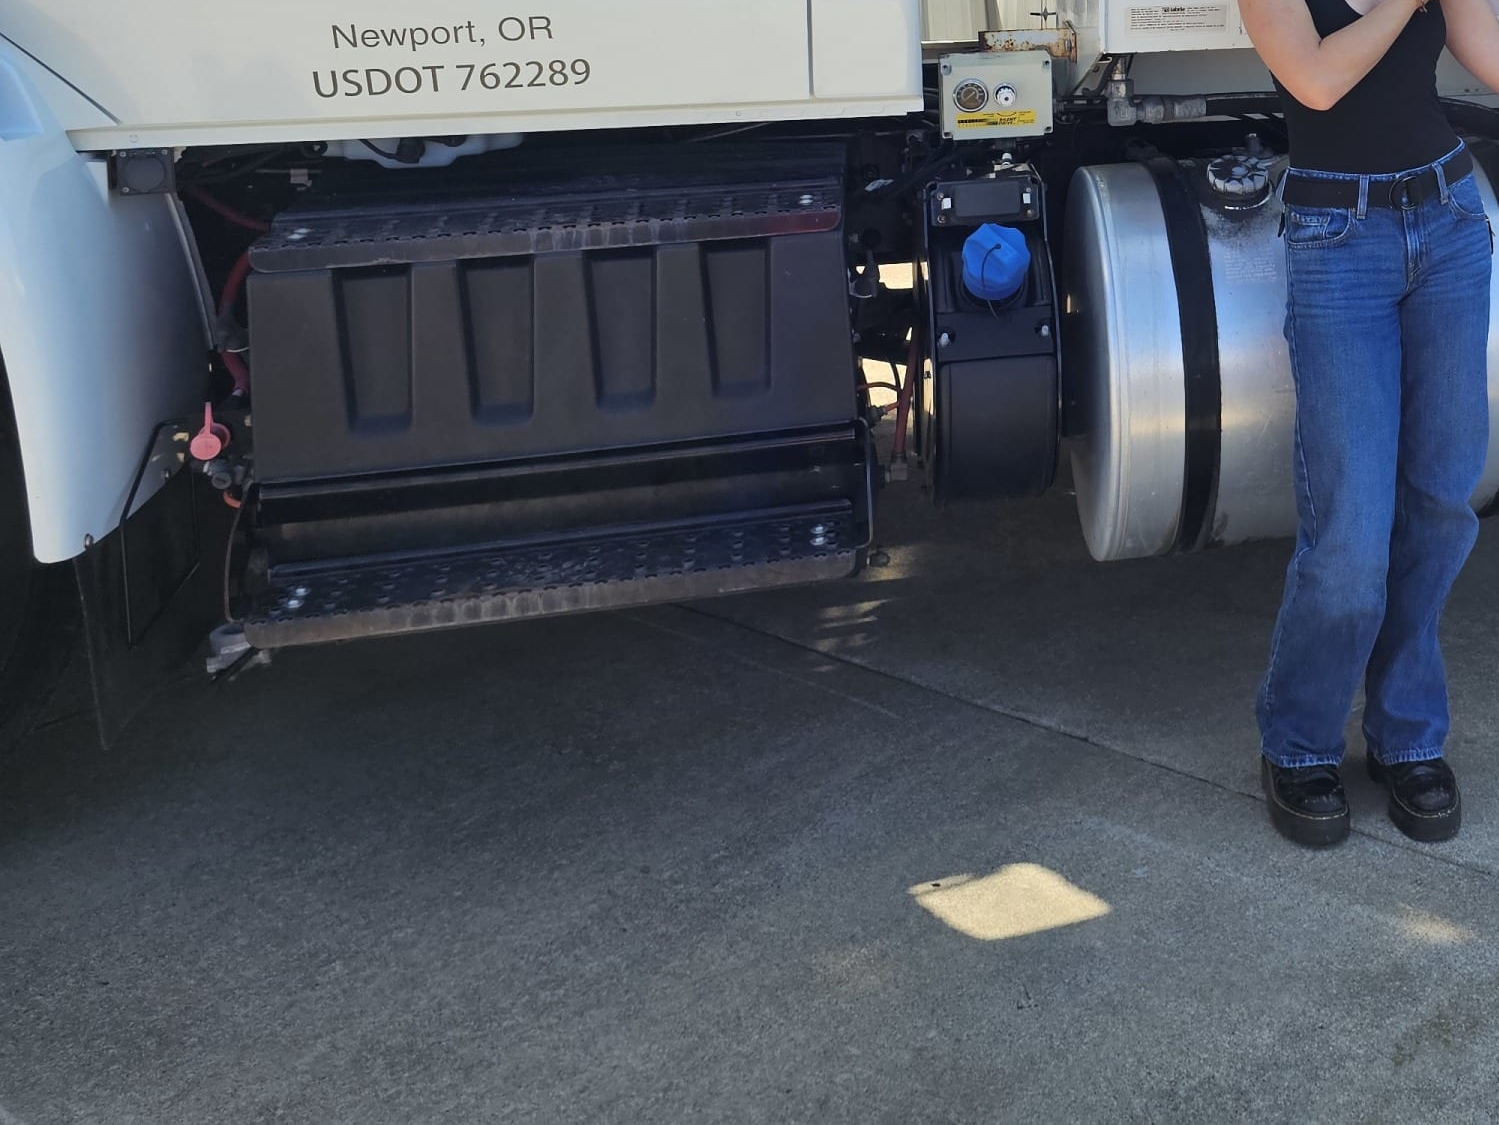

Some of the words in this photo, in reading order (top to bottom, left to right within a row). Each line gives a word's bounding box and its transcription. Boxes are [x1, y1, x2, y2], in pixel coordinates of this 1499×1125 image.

[331, 20, 486, 52] Newport,
[498, 15, 554, 42] OR
[312, 65, 445, 99] USDOT
[455, 58, 592, 91] 762289
